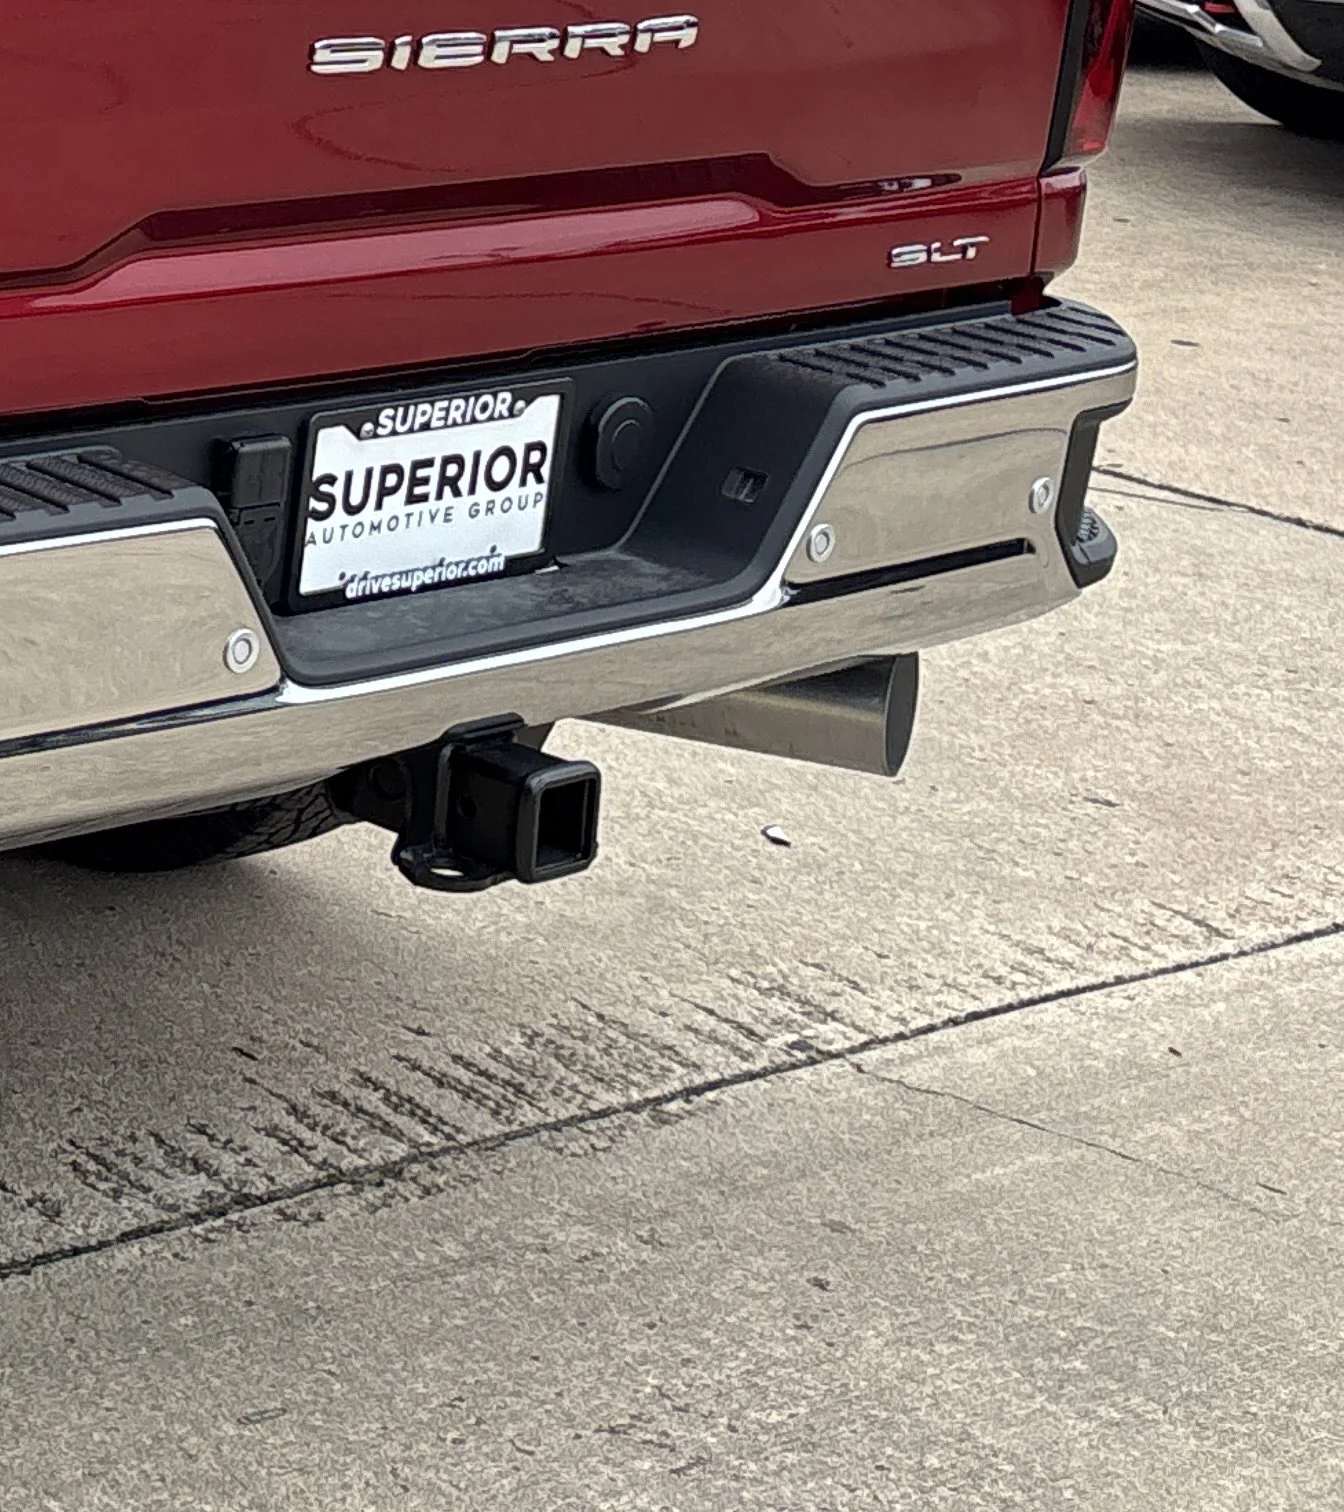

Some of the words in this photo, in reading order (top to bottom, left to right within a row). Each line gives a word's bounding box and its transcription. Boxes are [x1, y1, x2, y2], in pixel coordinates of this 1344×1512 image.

[310, 13, 699, 74] SIERRA
[889, 236, 990, 268] SLT
[376, 391, 513, 436] SUPERIOR
[308, 440, 548, 522] SUPERIOR
[304, 506, 455, 548] AUTOMOTIVE
[468, 491, 544, 520] GROUP
[345, 553, 506, 599] drivesuperior.com
